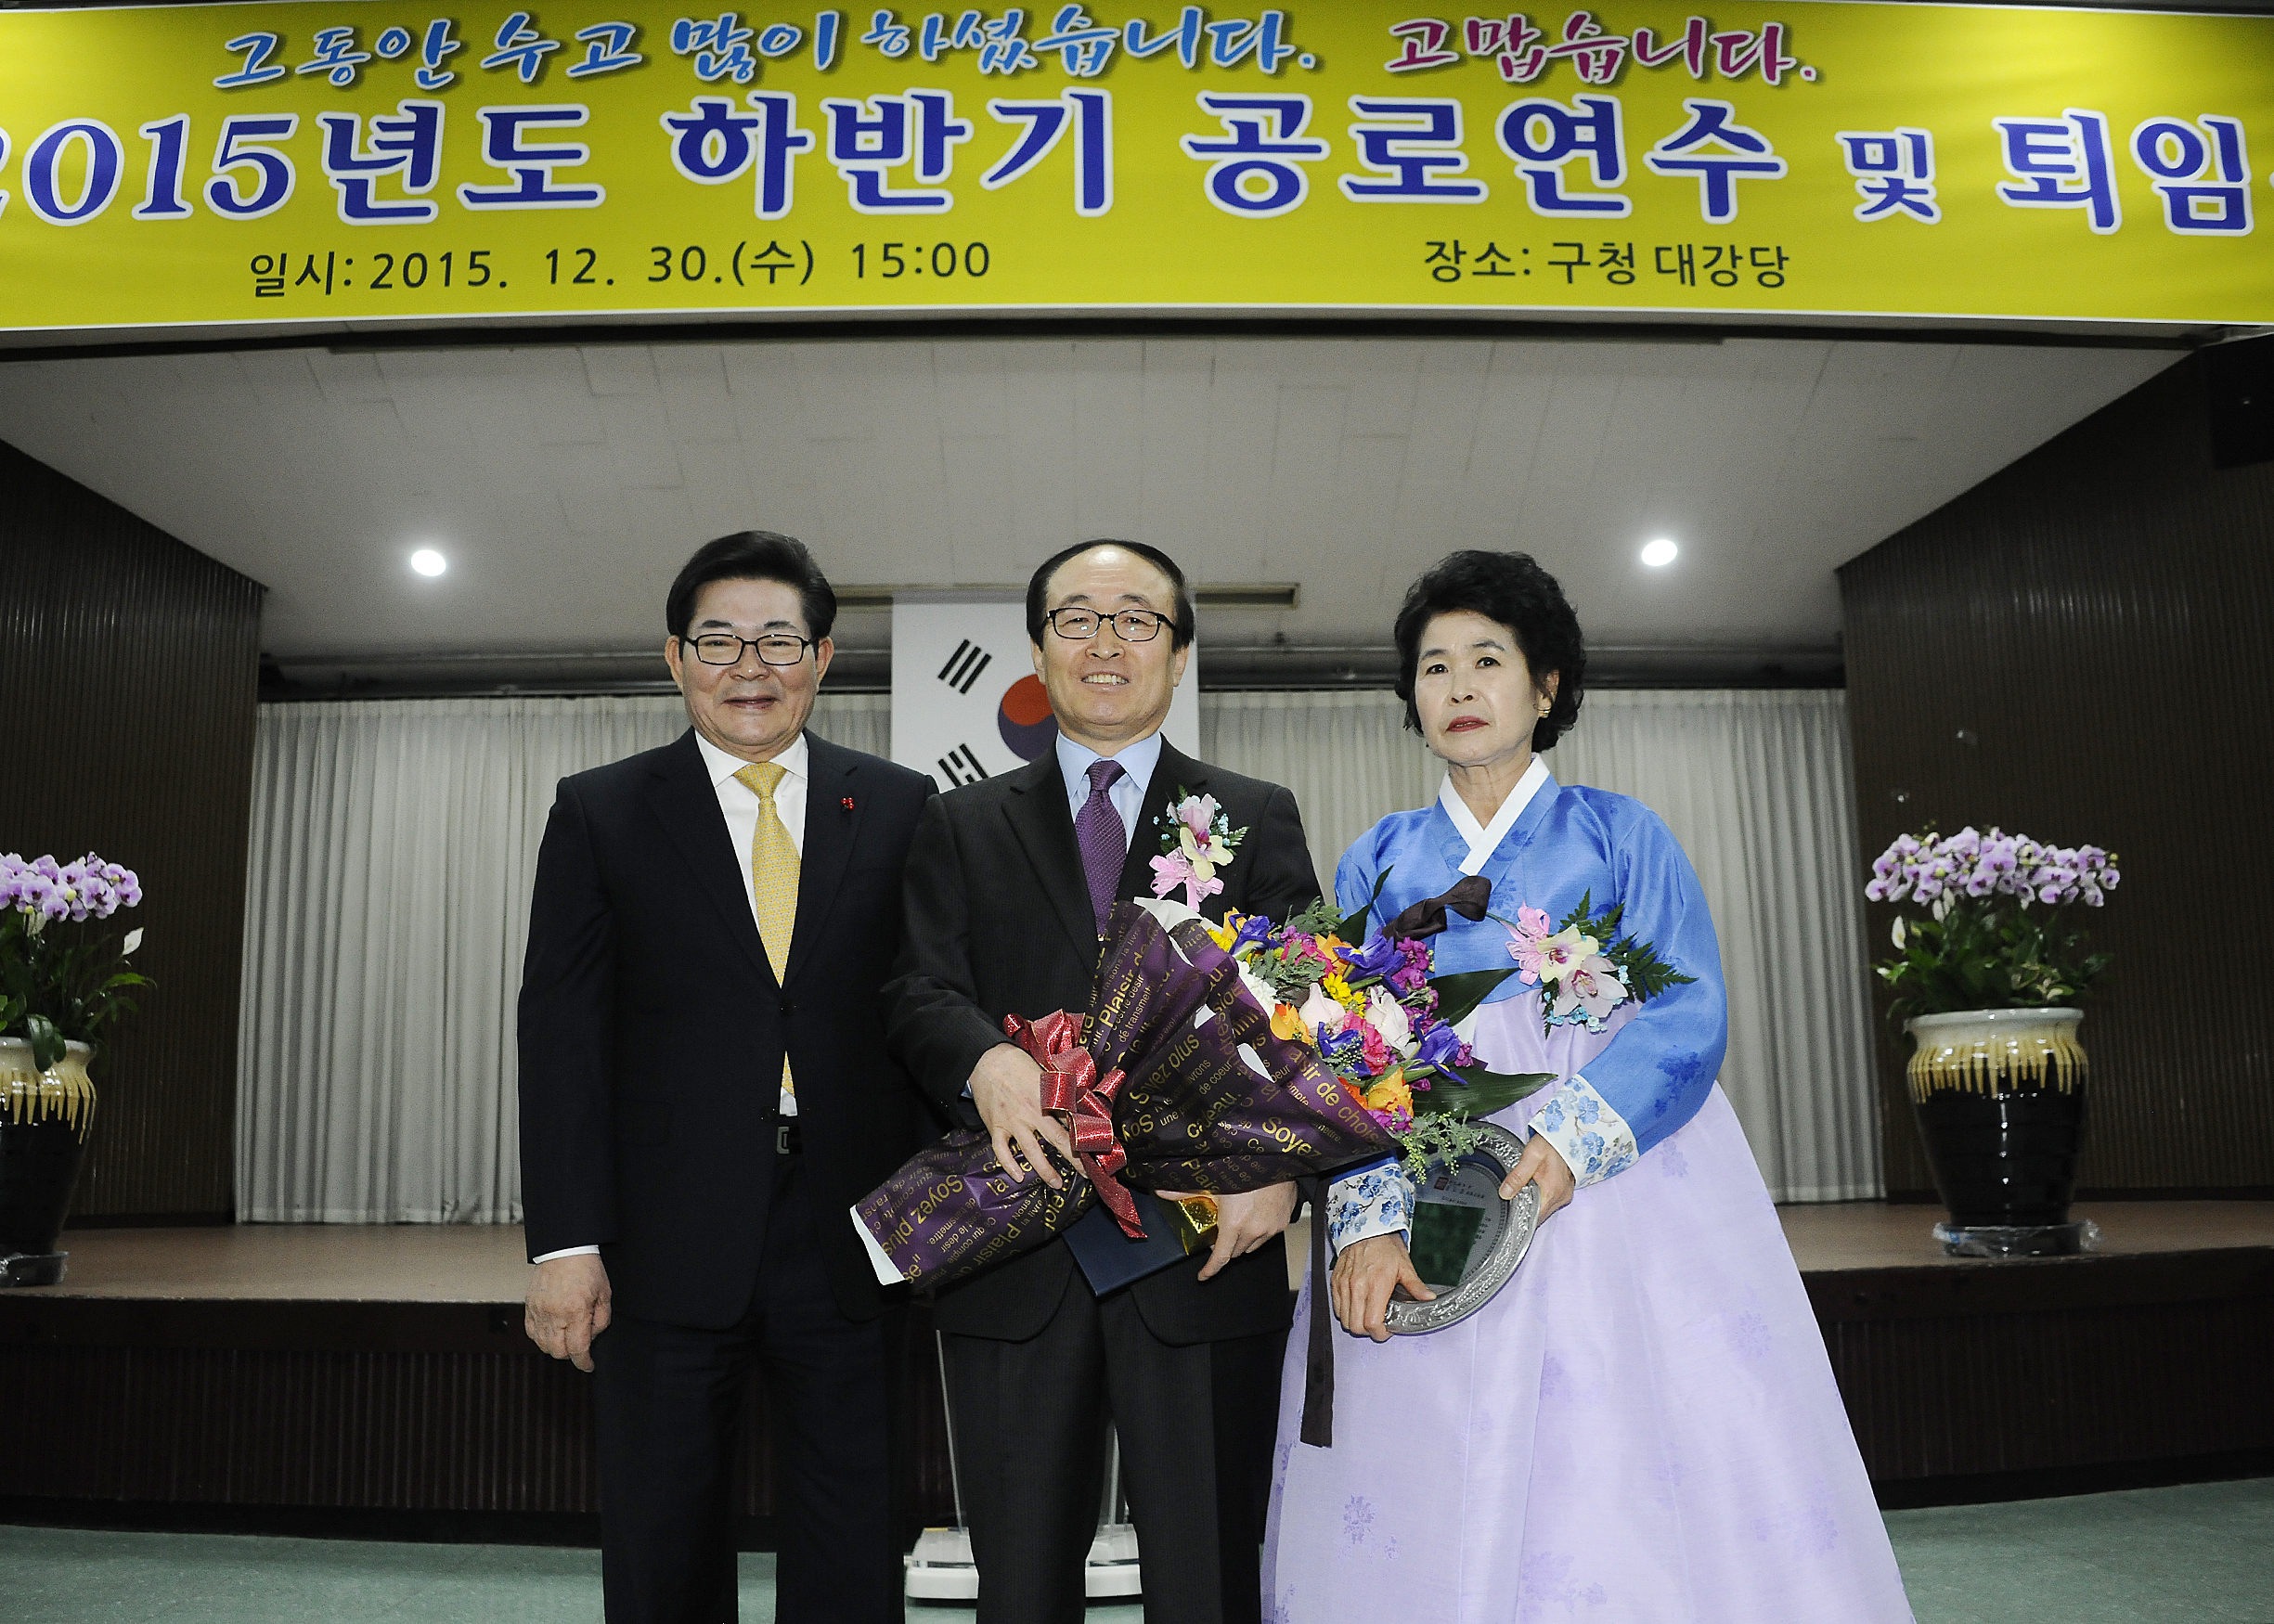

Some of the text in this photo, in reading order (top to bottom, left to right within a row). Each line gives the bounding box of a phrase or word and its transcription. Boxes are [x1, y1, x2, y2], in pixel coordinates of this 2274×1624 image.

[213, 5, 1319, 90] 그동안 수고 많이 하셨습니다.
[1383, 11, 1821, 87] 고맙습니다.
[0, 87, 2255, 237] 015년도 하반기 공로연수 및 퇴임
[249, 238, 991, 299] 일시: 2015. 12. 30.(수) 15:00
[1424, 239, 1791, 290] 장소: 구청 대강당
[1198, 1081, 1211, 1096] de
[1209, 1061, 1234, 1086] coeur
[1316, 1081, 1340, 1107] de
[910, 1174, 964, 1225] Soyez
[1012, 1198, 1032, 1220] Nous
[940, 1233, 961, 1254] desir
[975, 1222, 1022, 1267] Plaisir
